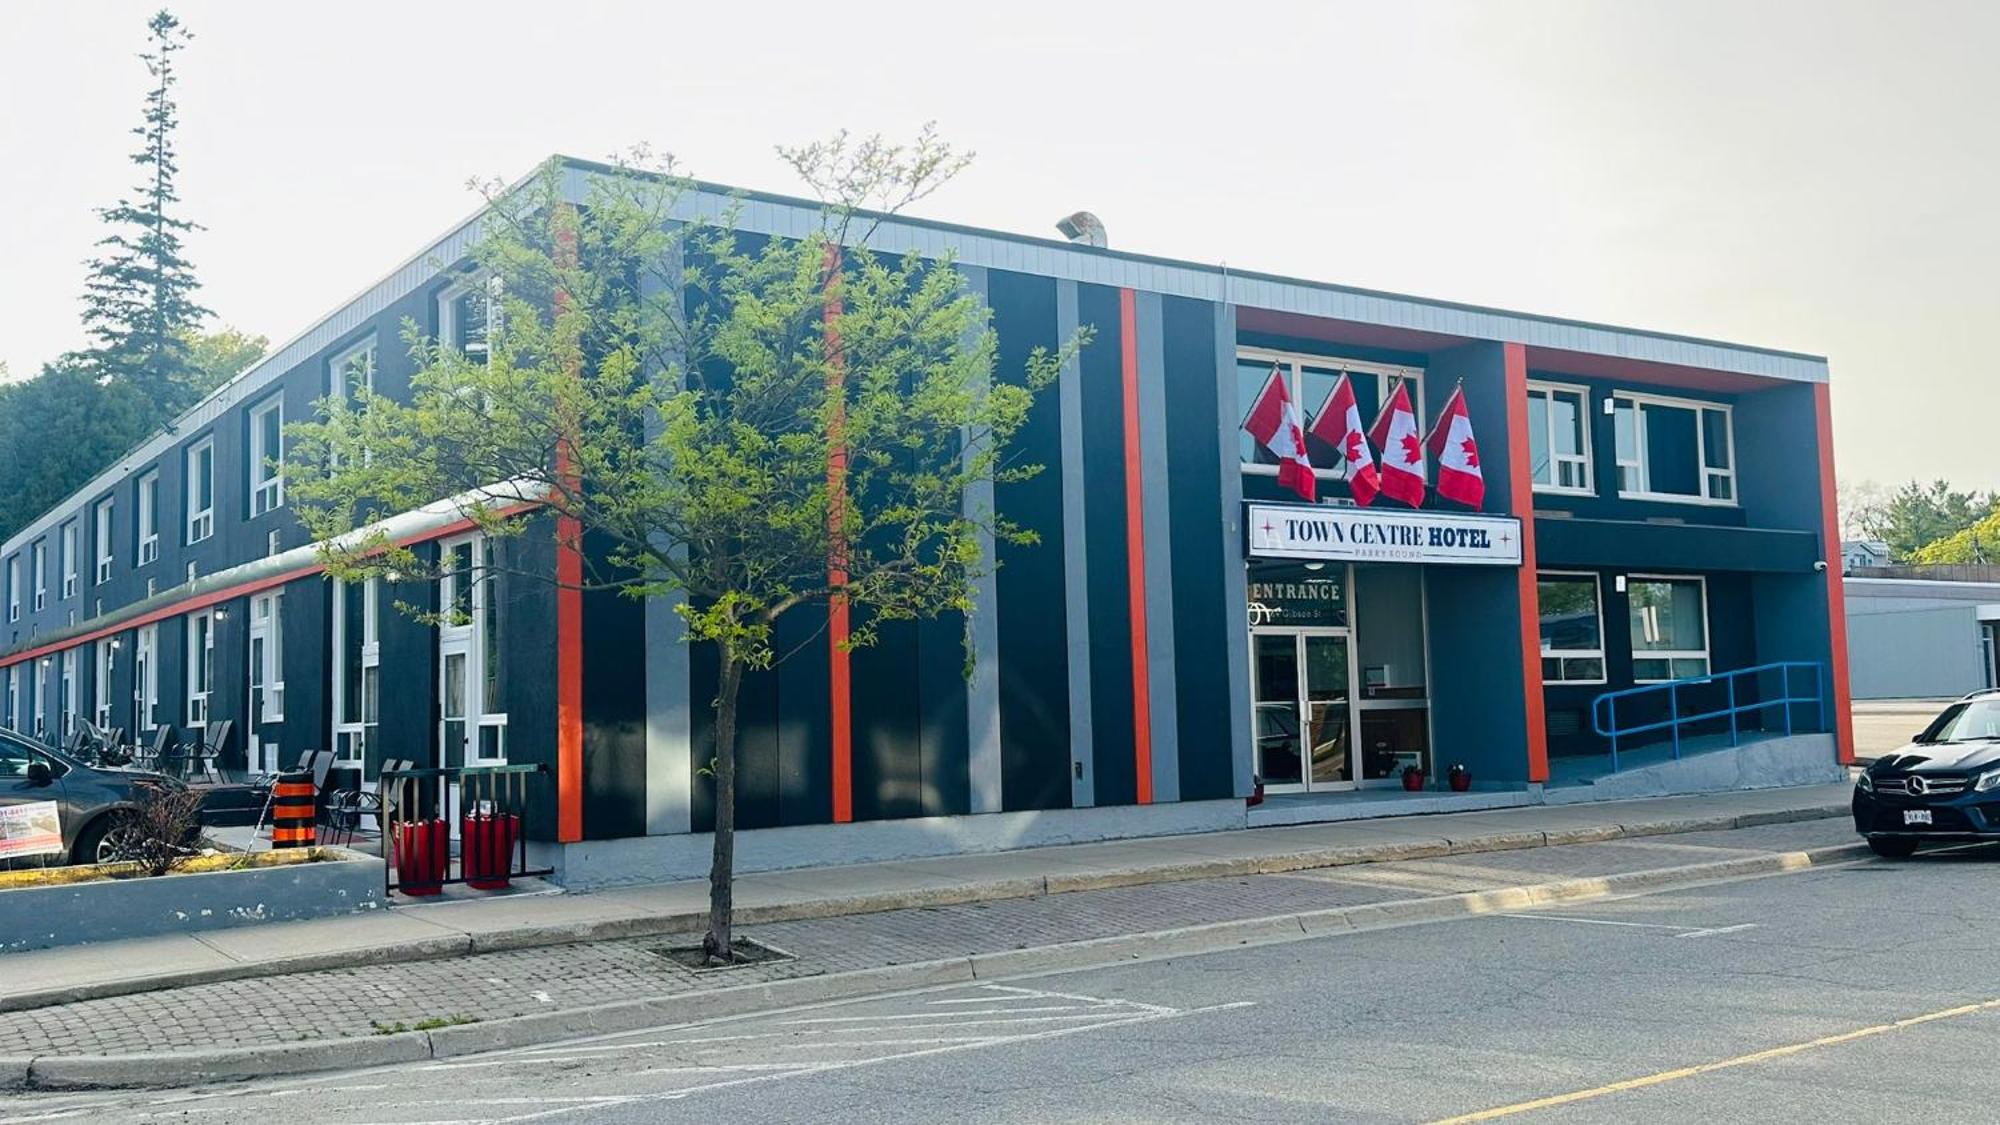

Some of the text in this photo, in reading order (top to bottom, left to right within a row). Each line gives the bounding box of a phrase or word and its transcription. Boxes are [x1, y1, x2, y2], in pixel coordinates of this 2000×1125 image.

[1285, 519, 1491, 549] TOWN CENTRE HOTEL
[1355, 548, 1422, 559] PARRY SOUND
[1253, 583, 1340, 600] ENTRANCE
